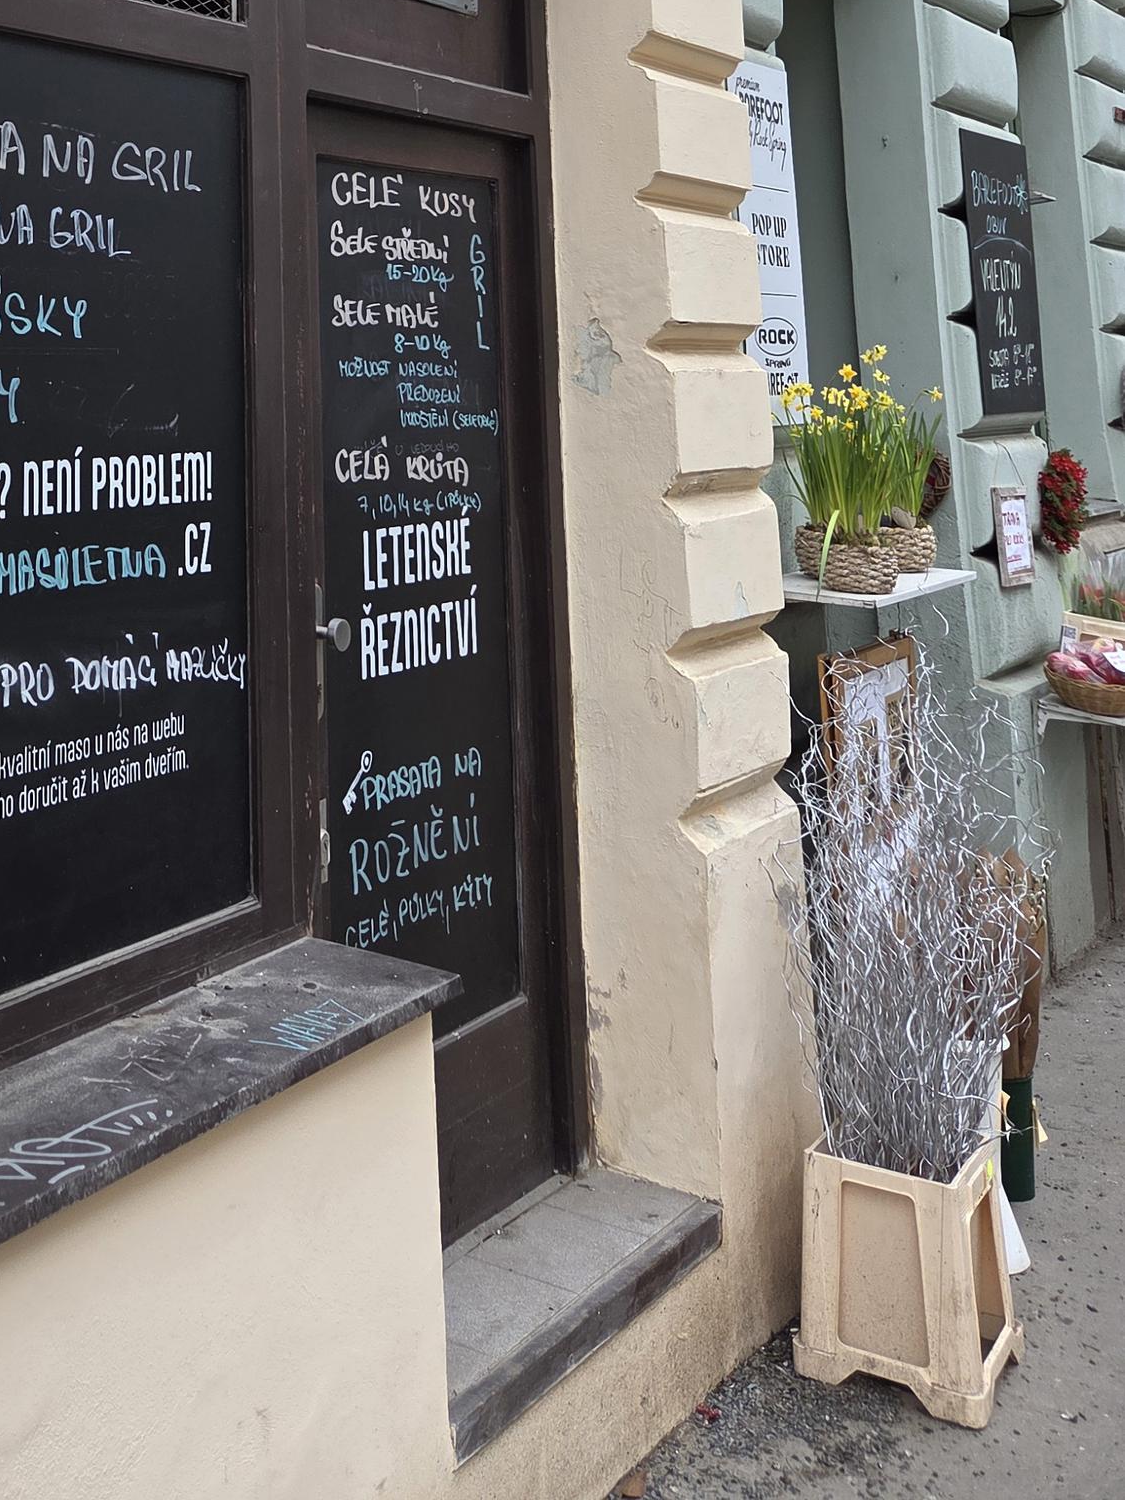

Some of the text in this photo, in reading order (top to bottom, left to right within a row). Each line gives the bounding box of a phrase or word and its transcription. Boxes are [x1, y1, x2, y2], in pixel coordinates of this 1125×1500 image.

[43, 134, 94, 184] NA
[112, 141, 202, 192] GRIL
[50, 206, 131, 257] GRIL
[419, 185, 476, 223] KUSY
[751, 212, 787, 238] POP UP
[385, 291, 438, 328] MALÉ
[758, 329, 795, 345] ROCK
[23, 446, 83, 517] NENÍ
[92, 451, 212, 511] PROBLEM!
[362, 505, 471, 591] LETENSKÉ
[360, 584, 478, 680] ŘEZNICTVÍ
[54, 737, 90, 767] maso
[95, 733, 103, 756] u
[107, 724, 129, 752] nás
[133, 723, 148, 746] na
[152, 711, 185, 741] webu
[19, 774, 68, 813] doručit
[72, 768, 87, 799] až
[91, 767, 99, 795] k
[103, 758, 141, 791] vašim
[145, 746, 190, 779] dveřím.
[360, 747, 481, 811] PRASATA NA
